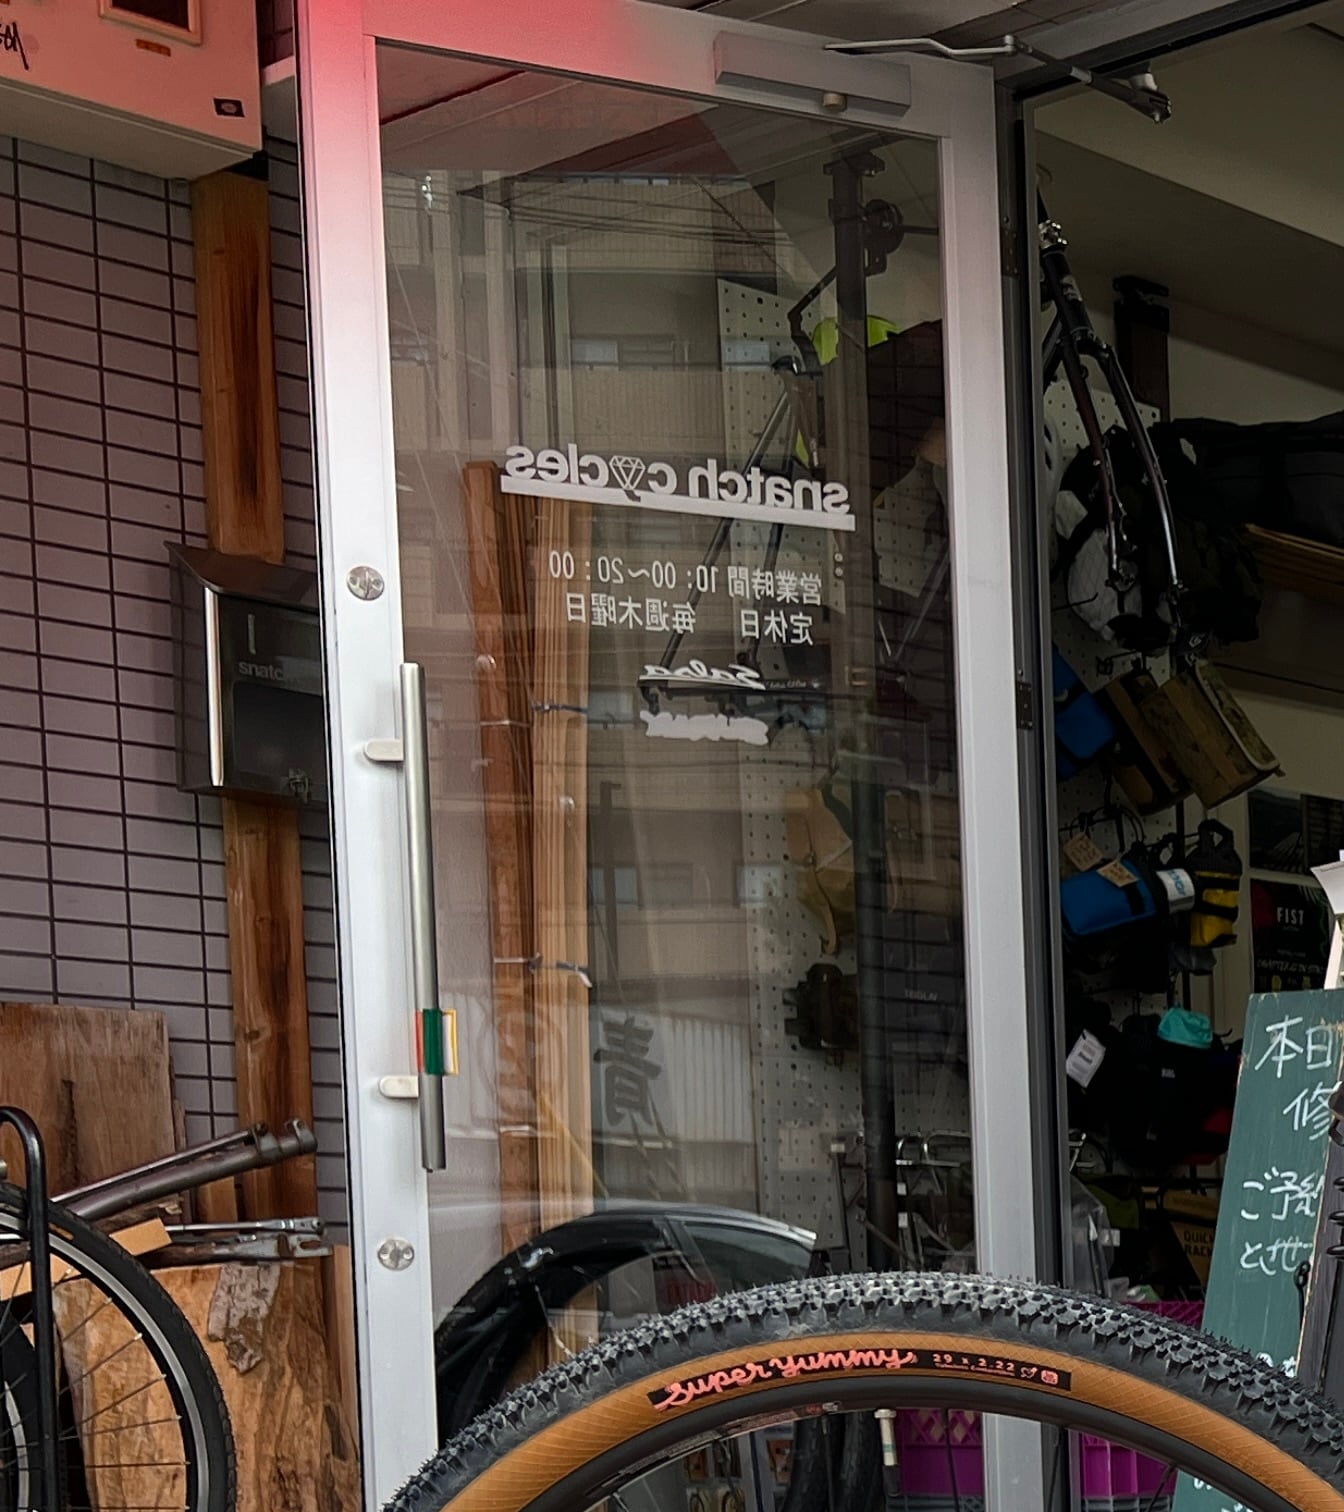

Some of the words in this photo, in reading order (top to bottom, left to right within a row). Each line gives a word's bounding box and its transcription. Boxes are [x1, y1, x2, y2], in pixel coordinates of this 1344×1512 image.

[1254, 1015, 1333, 1079] 本日
[932, 1352, 953, 1365] 29
[977, 1357, 1016, 1372] 2.22
